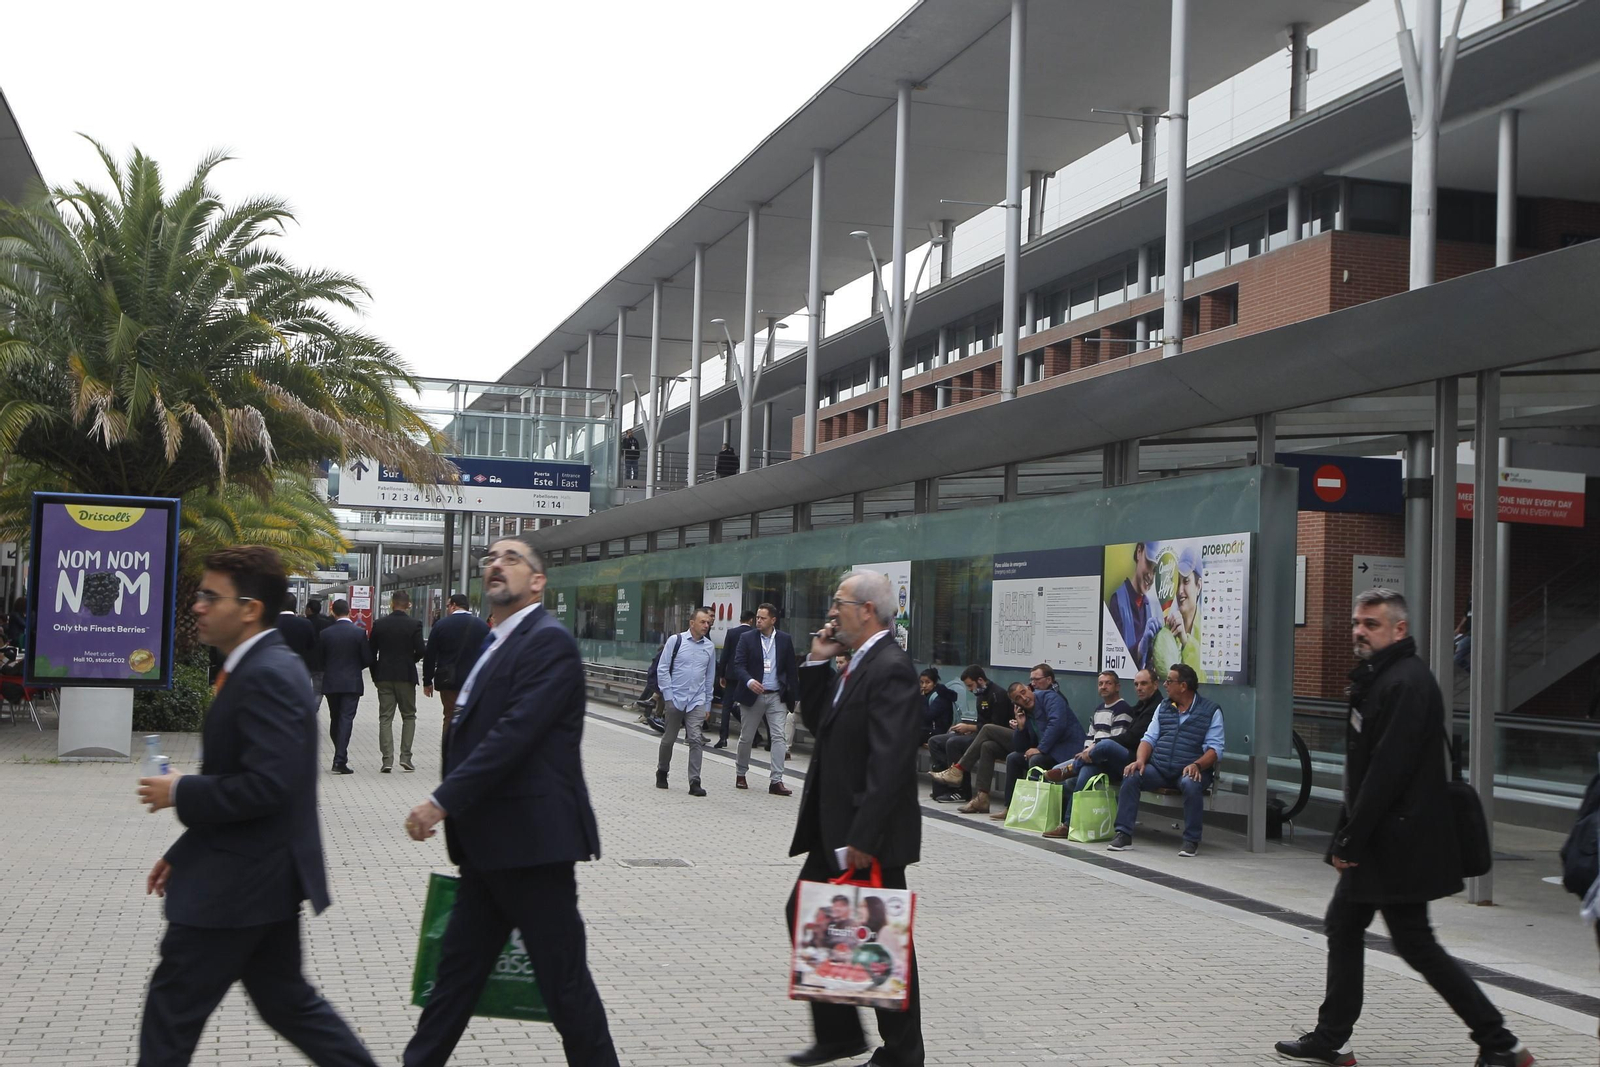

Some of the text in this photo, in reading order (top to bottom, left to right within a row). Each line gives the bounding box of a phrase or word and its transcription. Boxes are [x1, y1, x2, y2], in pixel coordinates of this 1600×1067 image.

[382, 470, 399, 478] Sur
[533, 478, 553, 486] Este
[561, 479, 579, 487] East
[381, 492, 385, 500] 1
[391, 493, 397, 501] 2
[403, 493, 408, 501] 3
[413, 494, 419, 502] 4
[446, 496, 452, 504] 7
[457, 496, 463, 504] 8
[1516, 497, 1533, 506] NEW
[1534, 498, 1556, 508] EVERY
[1558, 500, 1573, 508] DAY
[536, 500, 561, 509] 12 14
[79, 510, 131, 522] Driscoll's
[1462, 503, 1474, 511] YO
[1521, 507, 1528, 515] IN
[1530, 508, 1551, 517] EVERY
[1553, 510, 1568, 518] WAY
[1202, 540, 1245, 559] proexport
[57, 550, 150, 570] NOM NOM
[53, 623, 72, 633] Only
[74, 624, 88, 632] the
[90, 625, 115, 633] Finest
[1105, 655, 1126, 669] Hall 7
